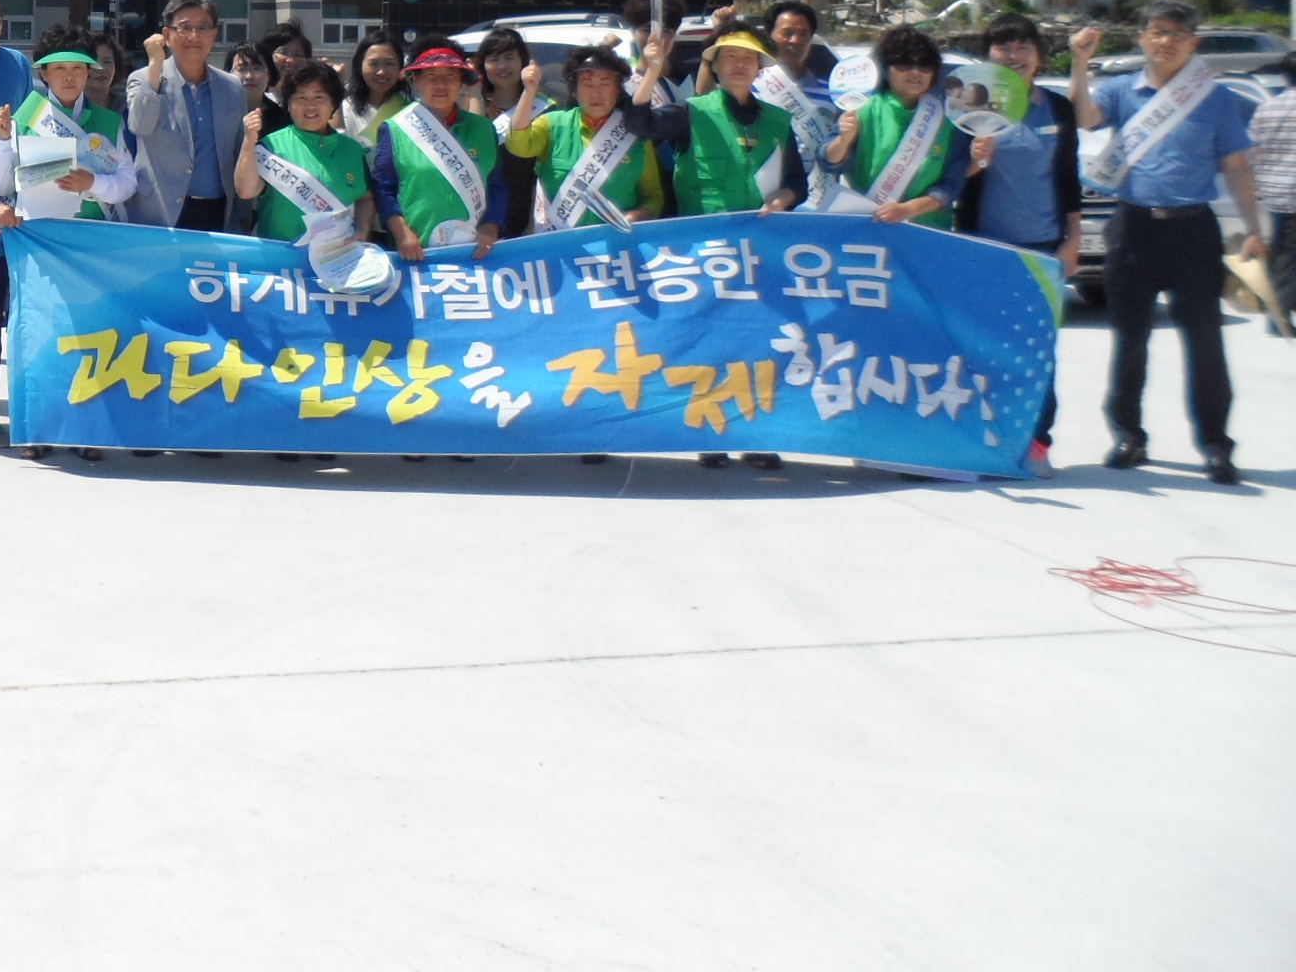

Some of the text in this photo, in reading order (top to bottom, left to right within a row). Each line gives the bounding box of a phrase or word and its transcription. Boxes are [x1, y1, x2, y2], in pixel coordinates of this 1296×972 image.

[433, 141, 452, 159] 다시
[265, 158, 284, 176] 다시
[556, 189, 581, 224] 확립합
[573, 238, 760, 309] 편승한
[781, 242, 893, 309] 요금
